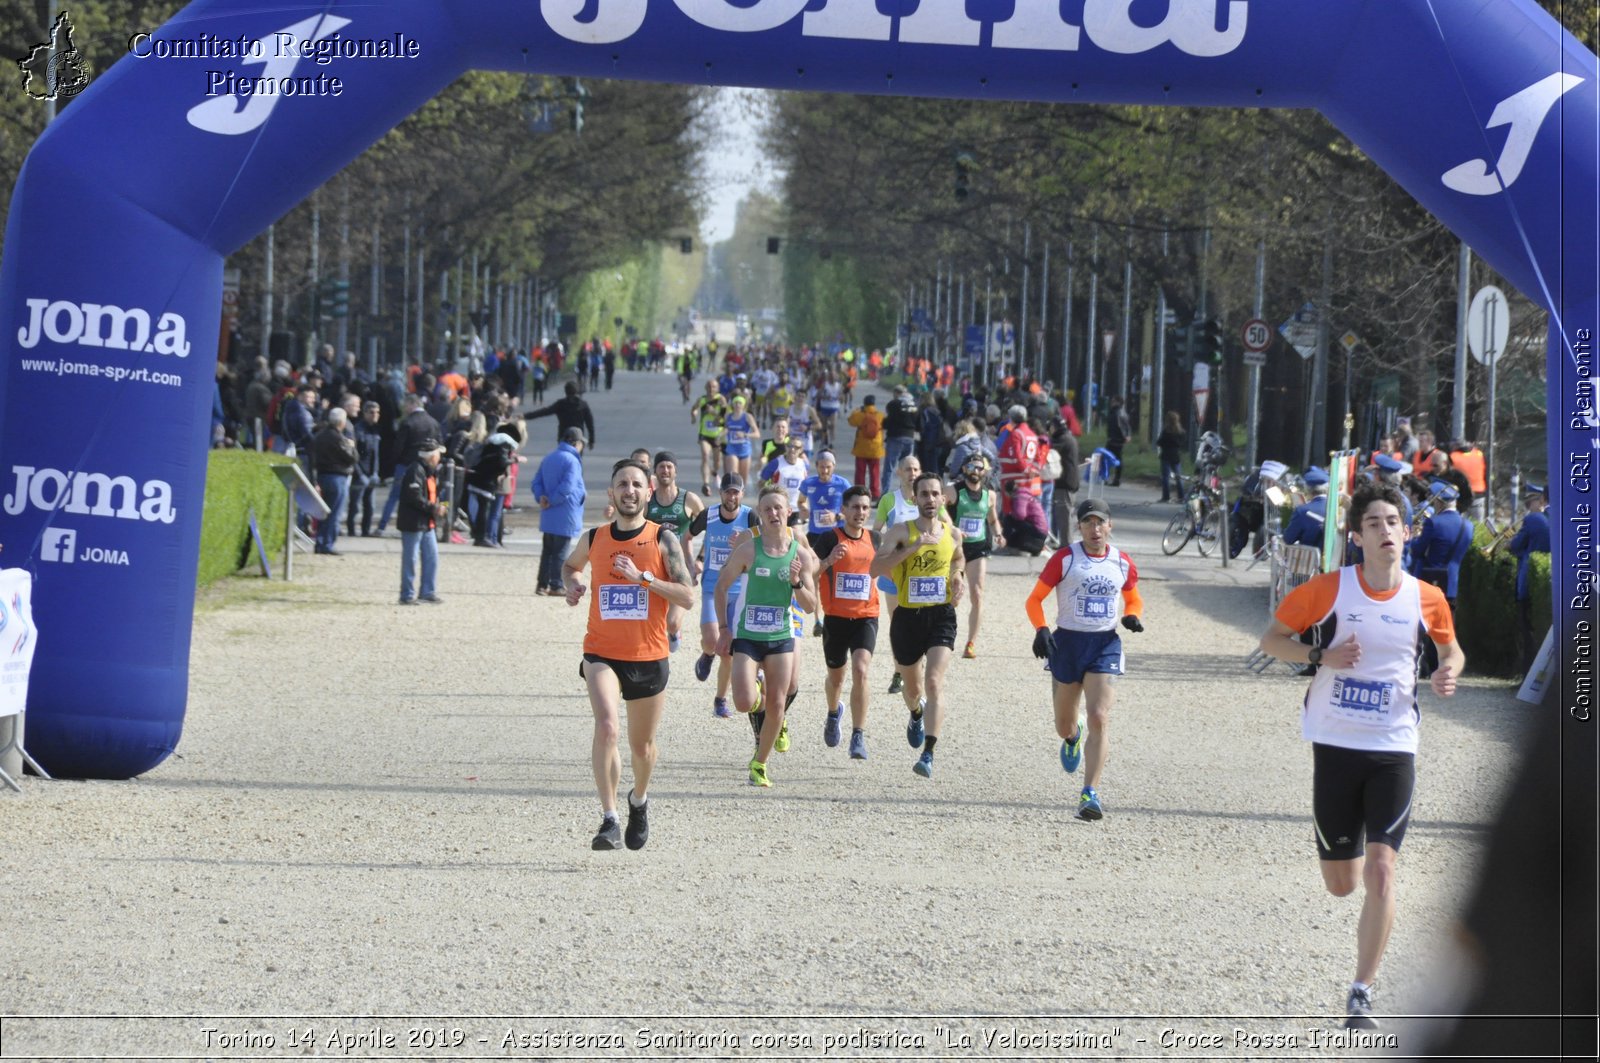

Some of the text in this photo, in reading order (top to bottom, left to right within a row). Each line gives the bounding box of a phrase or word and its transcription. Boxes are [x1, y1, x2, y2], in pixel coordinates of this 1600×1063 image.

[1249, 327, 1265, 344] 50
[21, 358, 182, 387] www.joma-sport.com
[80, 547, 130, 566] JOMA
[920, 582, 936, 592] 292
[612, 592, 634, 605] 296
[1087, 602, 1105, 613] 300
[1344, 686, 1380, 705] 1706
